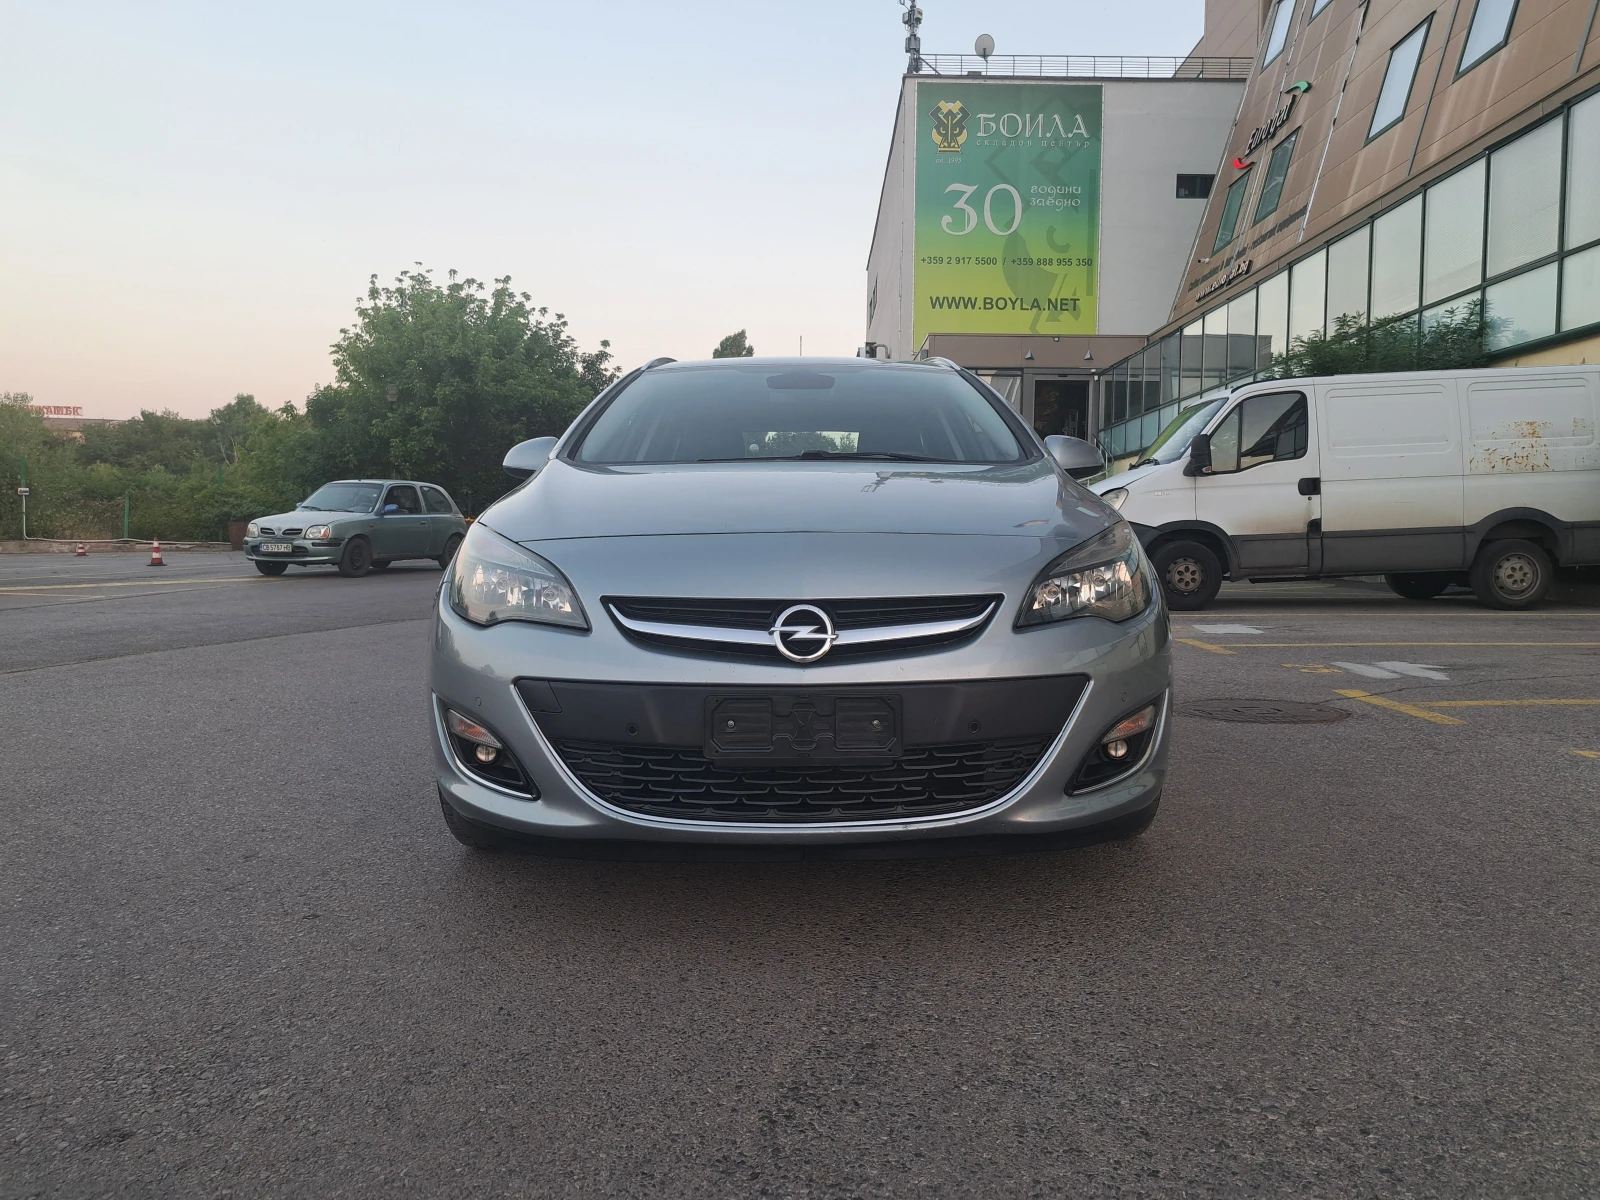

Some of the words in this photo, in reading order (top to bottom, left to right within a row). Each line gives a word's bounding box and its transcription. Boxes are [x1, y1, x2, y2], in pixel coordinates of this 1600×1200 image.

[976, 112, 1090, 138] БОИЛА
[976, 139, 1032, 148] складов
[1041, 139, 1090, 149] център
[1030, 185, 1082, 199] години
[941, 183, 1022, 236] 30
[920, 256, 944, 265] +359
[946, 256, 952, 265] 2
[955, 256, 972, 265] 917
[974, 257, 998, 266] 5500
[1010, 257, 1034, 266] +359
[1036, 257, 1054, 266] 888
[1056, 258, 1073, 267] 955
[1075, 258, 1093, 267] 350
[929, 296, 1080, 312] WWW.BOYLA.NET
